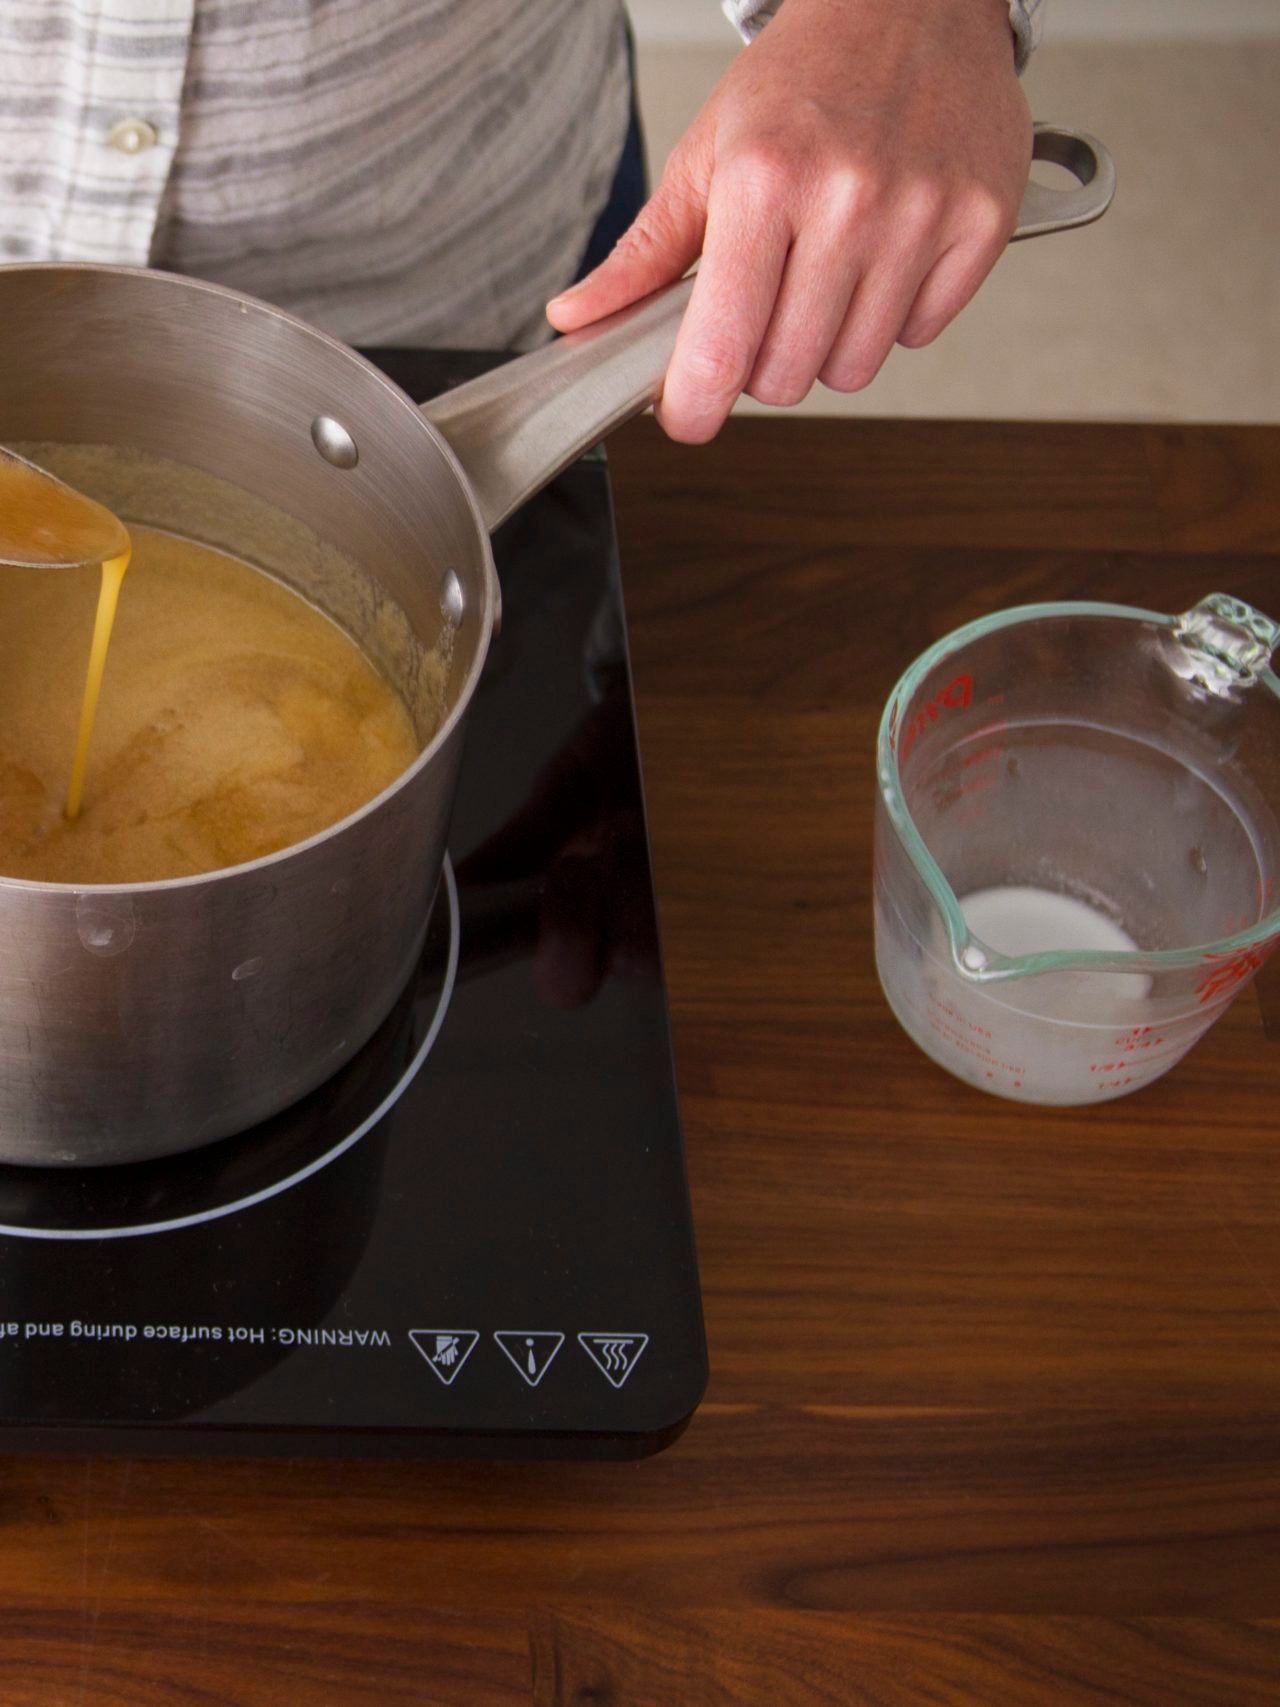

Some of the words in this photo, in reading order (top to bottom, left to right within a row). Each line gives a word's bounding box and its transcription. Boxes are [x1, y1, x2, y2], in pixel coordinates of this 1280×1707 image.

[25, 1323, 64, 1338] and
[70, 1320, 137, 1340] during
[143, 1325, 222, 1342] surface
[228, 1327, 265, 1342] Hot
[272, 1328, 390, 1345] WARNING:
